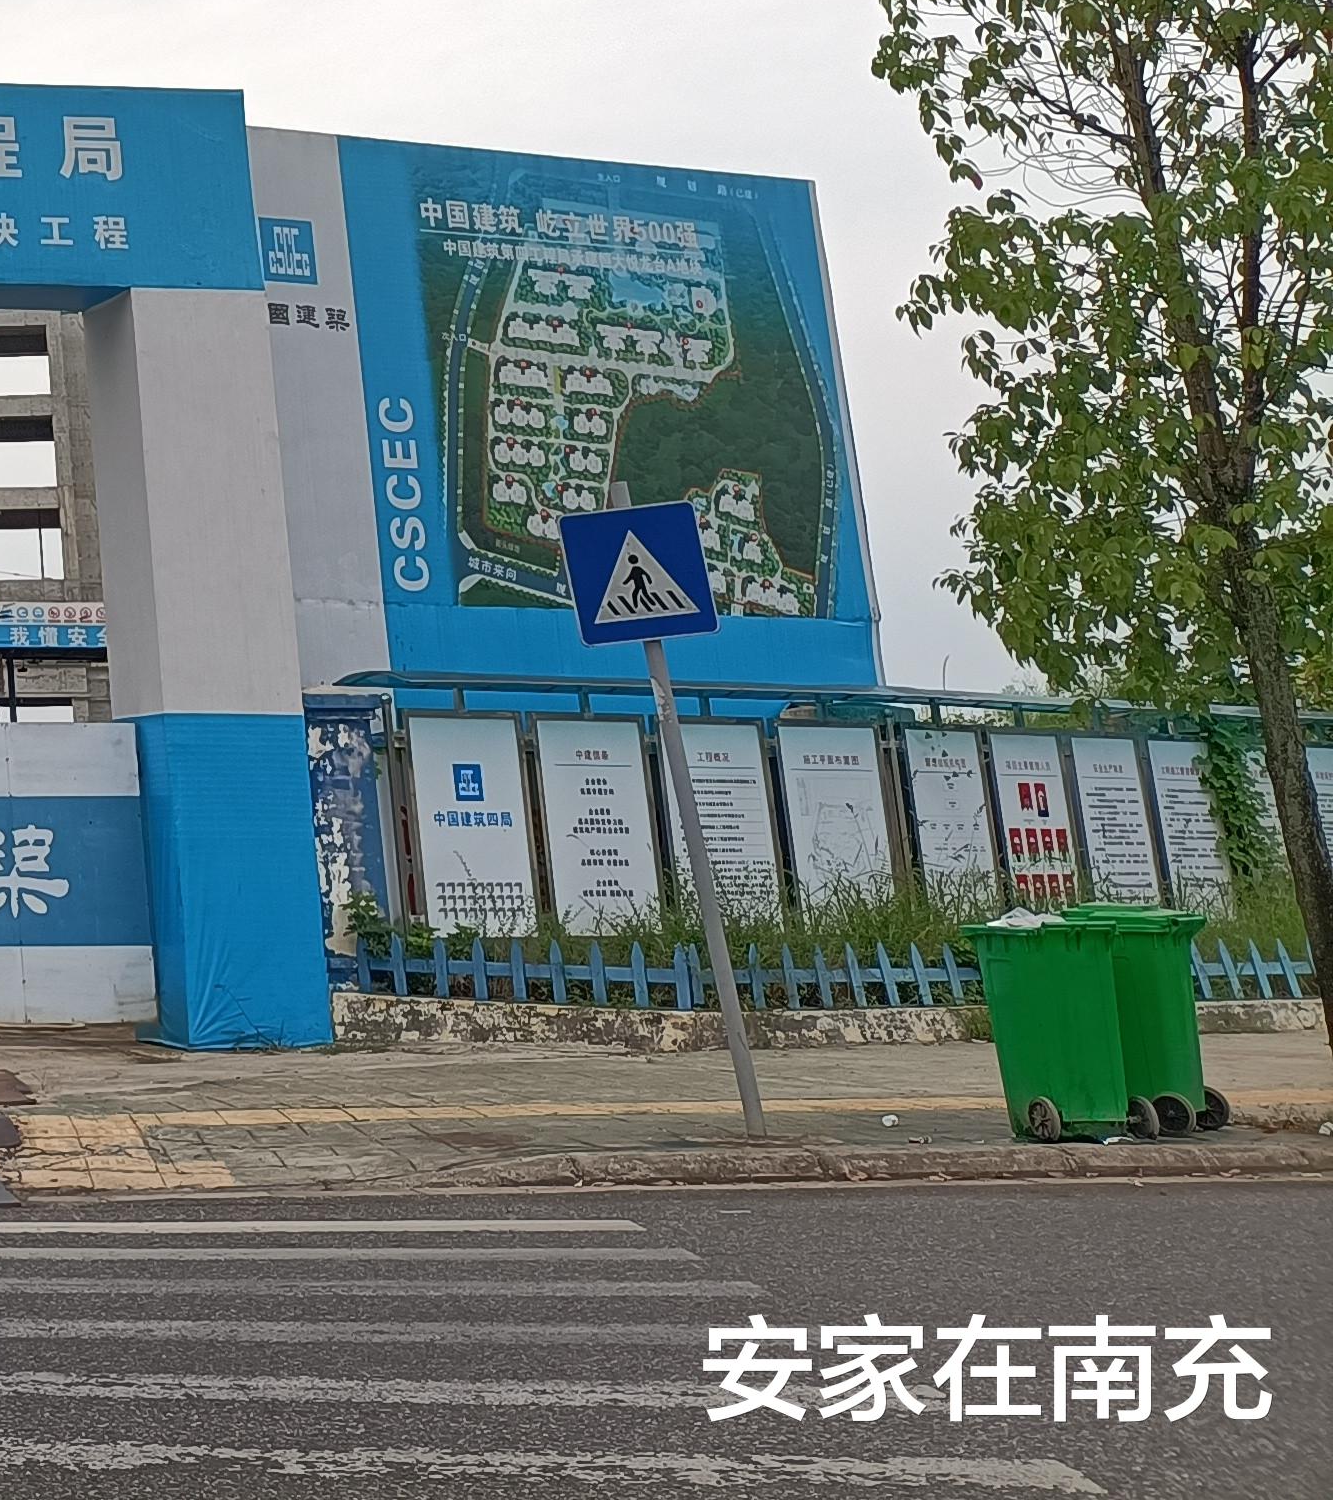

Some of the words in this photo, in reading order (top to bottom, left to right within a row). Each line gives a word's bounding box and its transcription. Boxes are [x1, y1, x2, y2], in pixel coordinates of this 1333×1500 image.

[419, 198, 523, 234] 中国建筑
[535, 209, 699, 249] 屹立世界500强
[378, 397, 430, 592] CSCEC
[467, 556, 517, 581] 城市来向
[434, 810, 513, 828] 中国建筑四局
